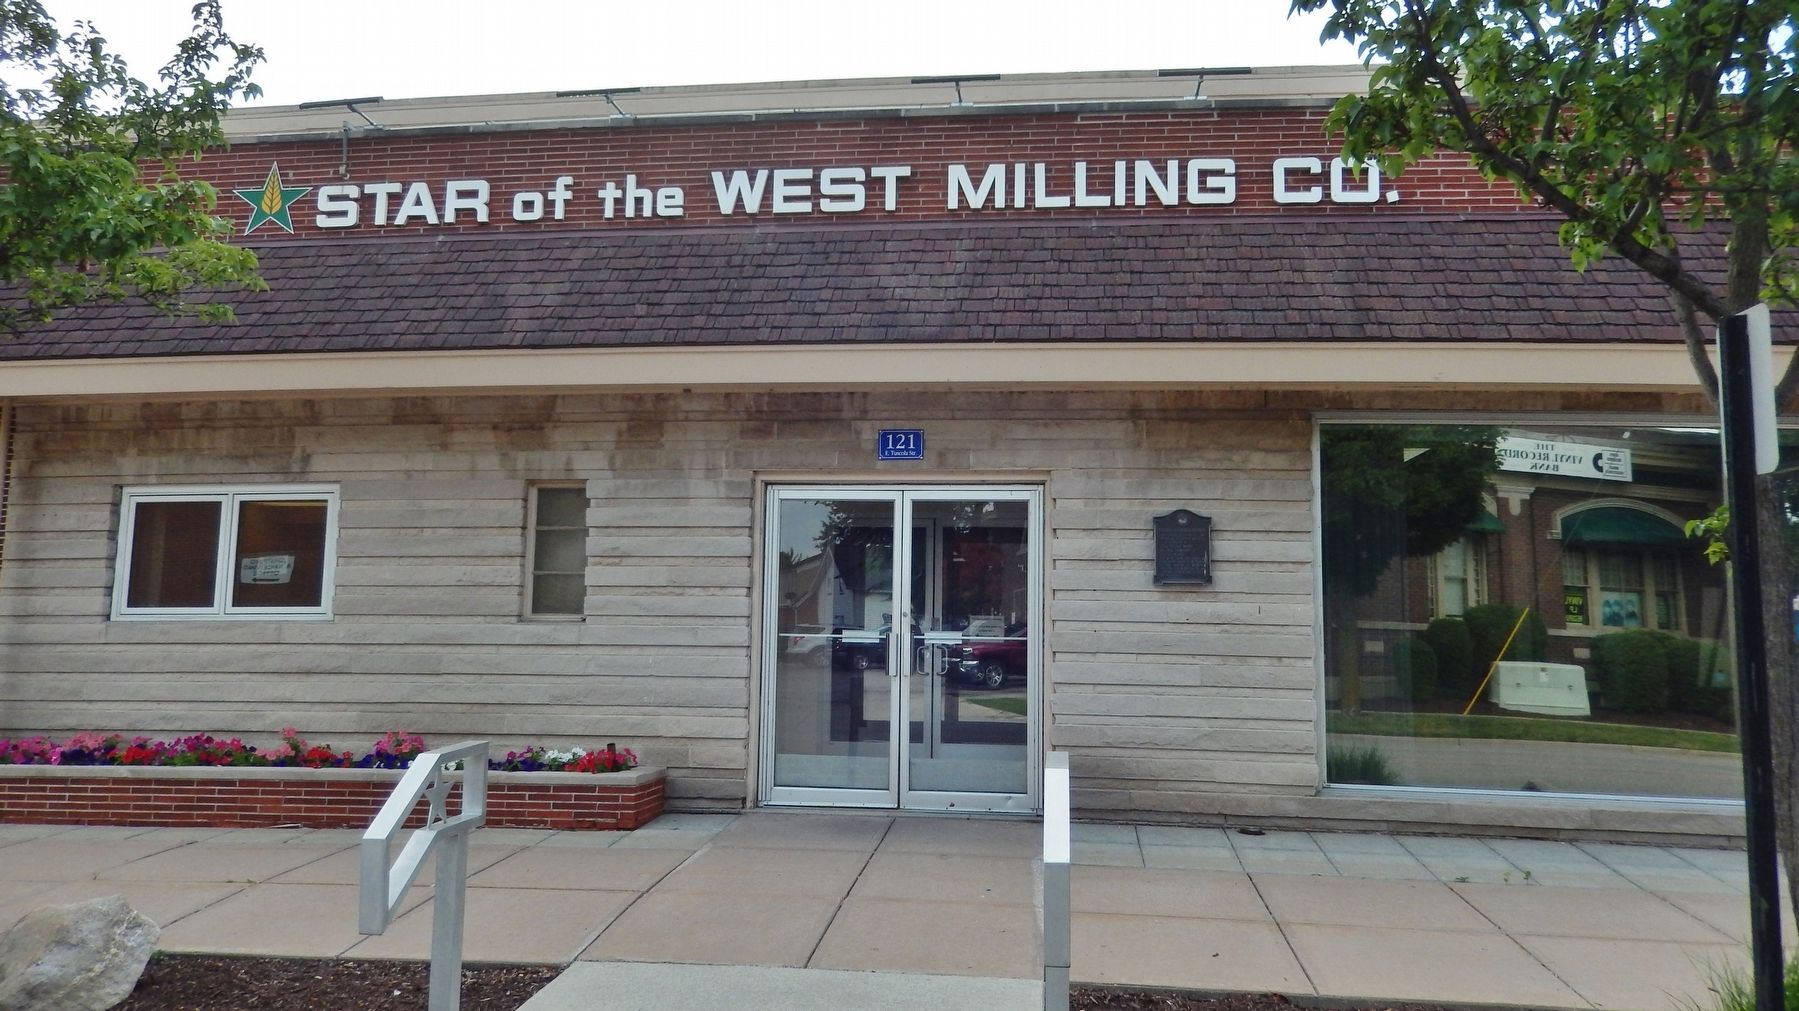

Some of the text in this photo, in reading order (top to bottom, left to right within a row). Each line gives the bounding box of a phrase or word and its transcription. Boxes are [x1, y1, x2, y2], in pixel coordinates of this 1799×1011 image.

[315, 156, 1400, 228] STAR of the WEST MILLING CO.
[887, 434, 915, 449] 121
